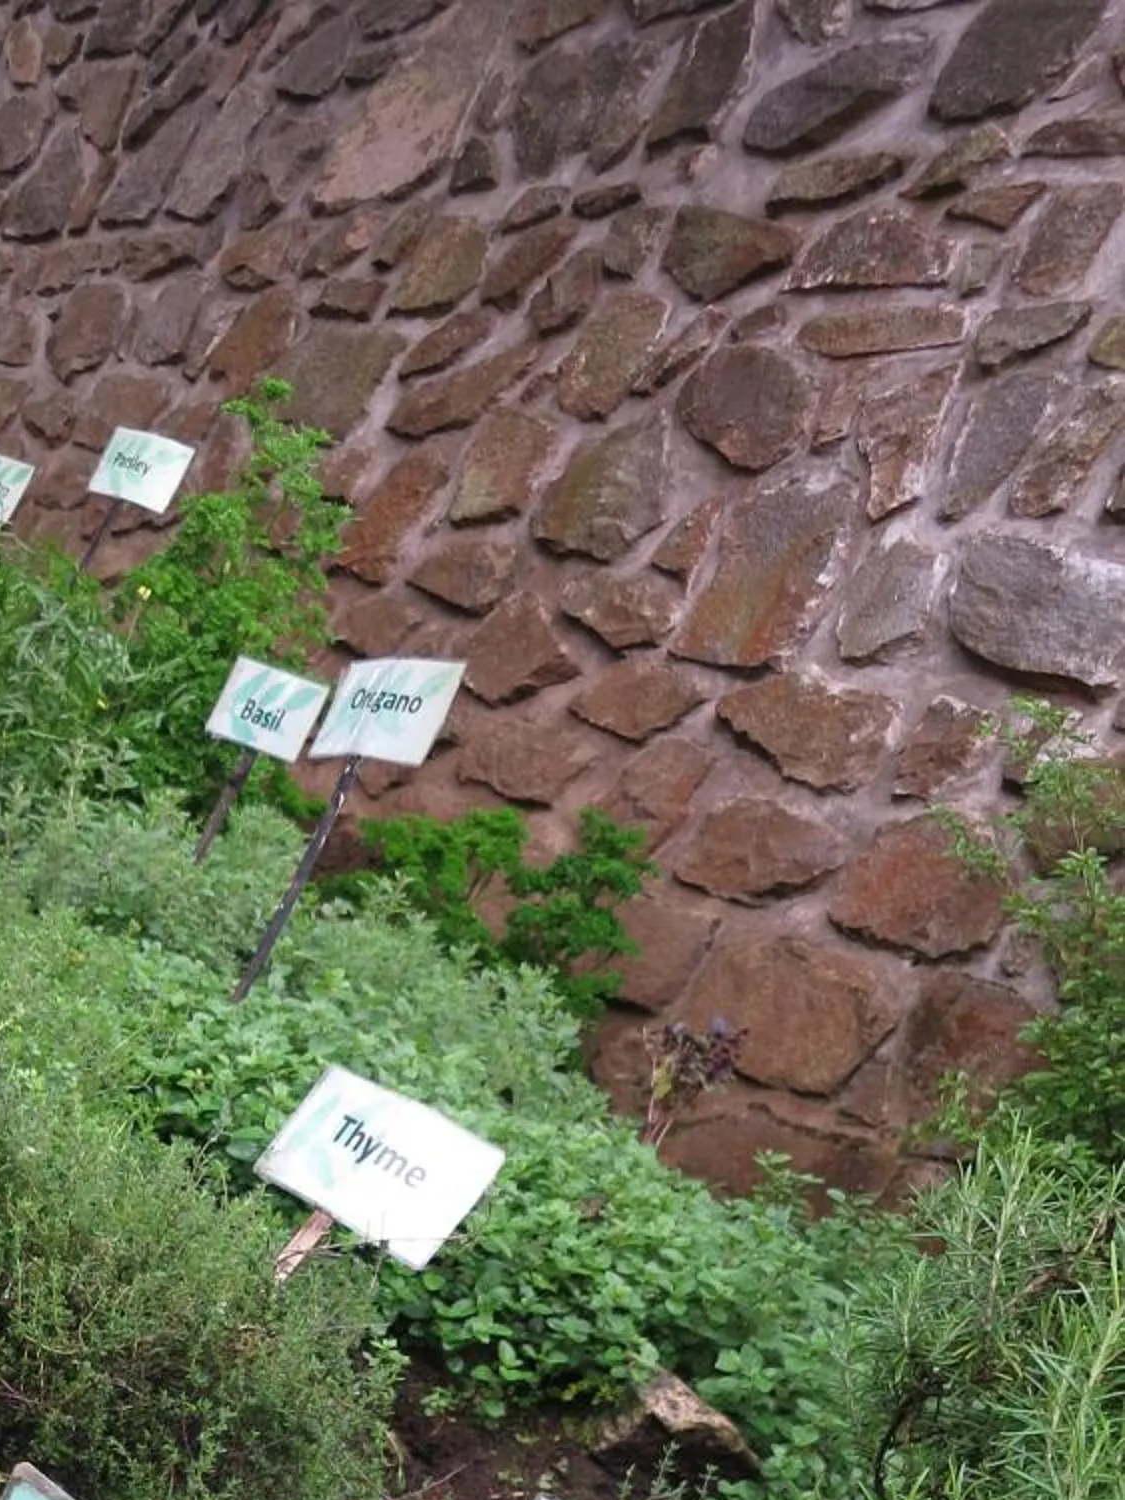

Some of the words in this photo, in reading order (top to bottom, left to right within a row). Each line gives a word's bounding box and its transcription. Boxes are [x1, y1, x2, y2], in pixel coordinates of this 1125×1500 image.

[240, 700, 286, 731] Basil
[351, 688, 423, 714] Origano
[333, 1114, 427, 1189] Thyme
